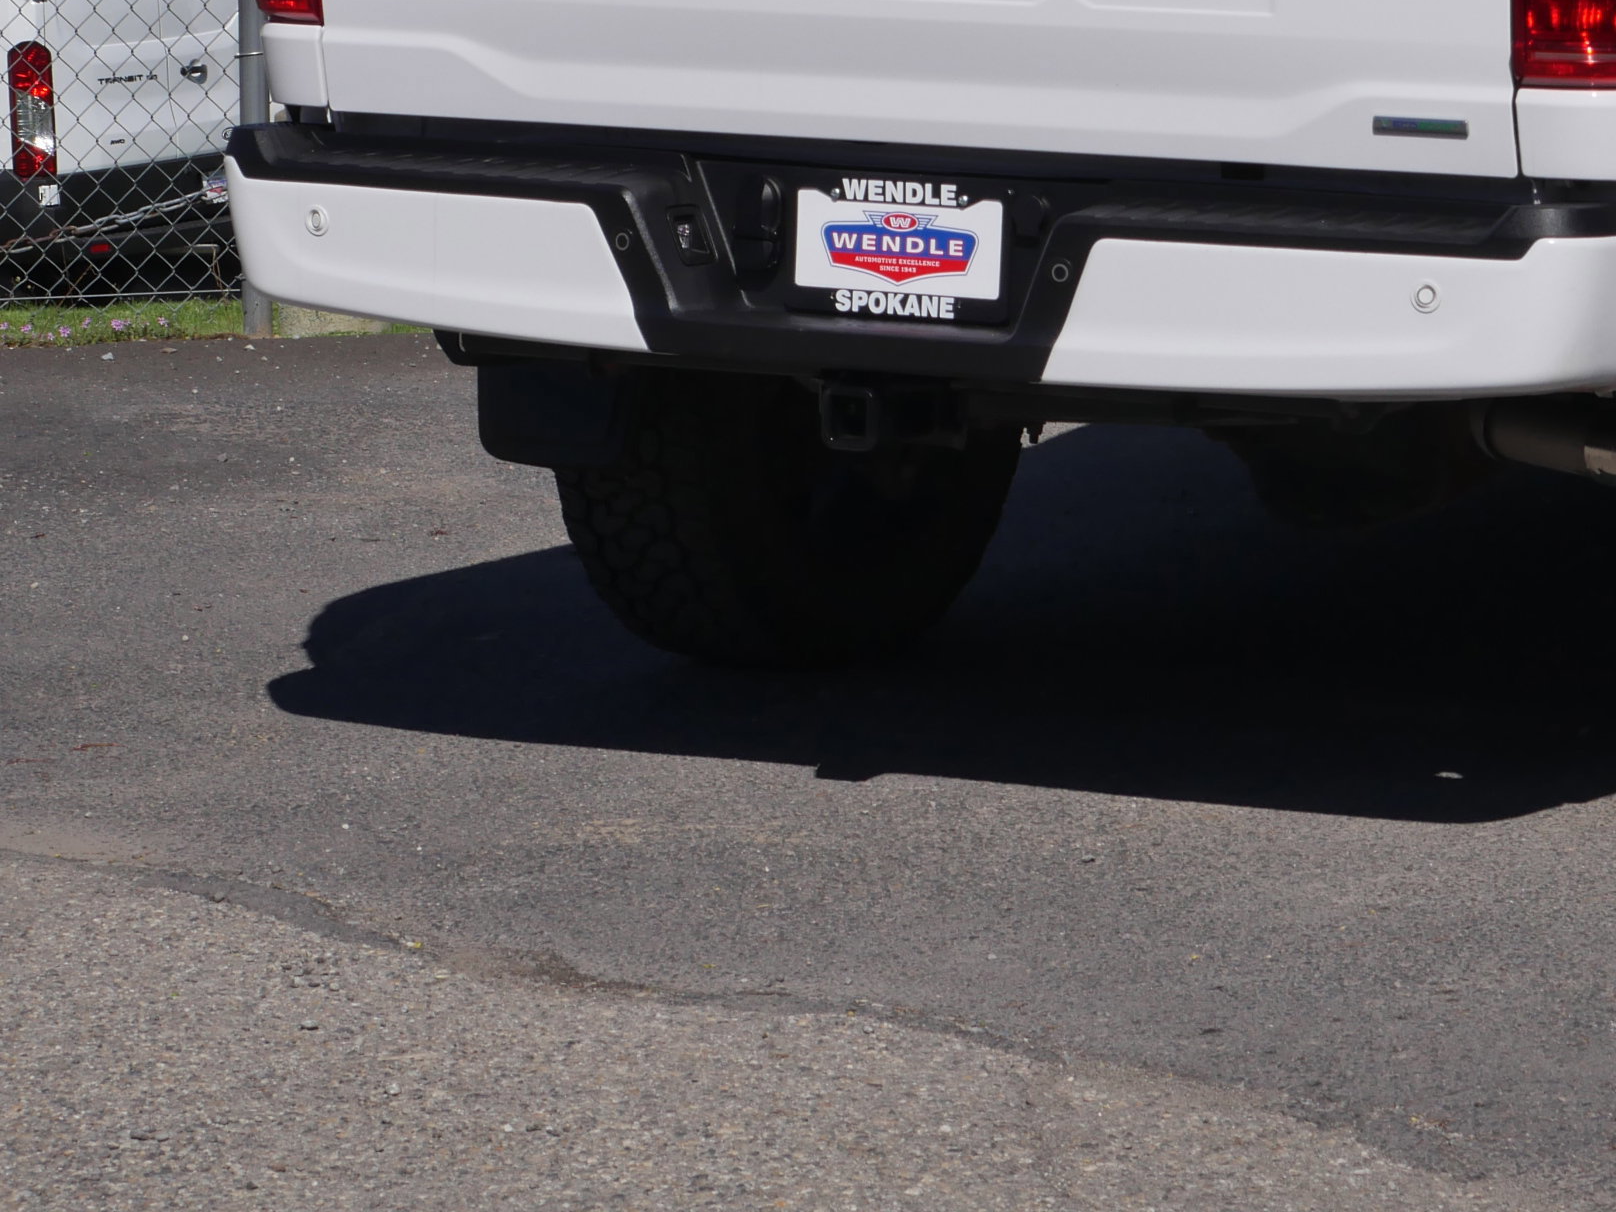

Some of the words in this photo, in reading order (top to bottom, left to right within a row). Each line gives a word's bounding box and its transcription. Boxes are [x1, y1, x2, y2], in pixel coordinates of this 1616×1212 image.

[842, 178, 957, 206] WENDLE
[832, 232, 964, 256] WENDLE
[854, 255, 897, 265] AUTOMOTIVE
[898, 258, 941, 267] EXCELLENCE
[879, 265, 900, 273] SINCE
[835, 289, 955, 319] SPOKANE
